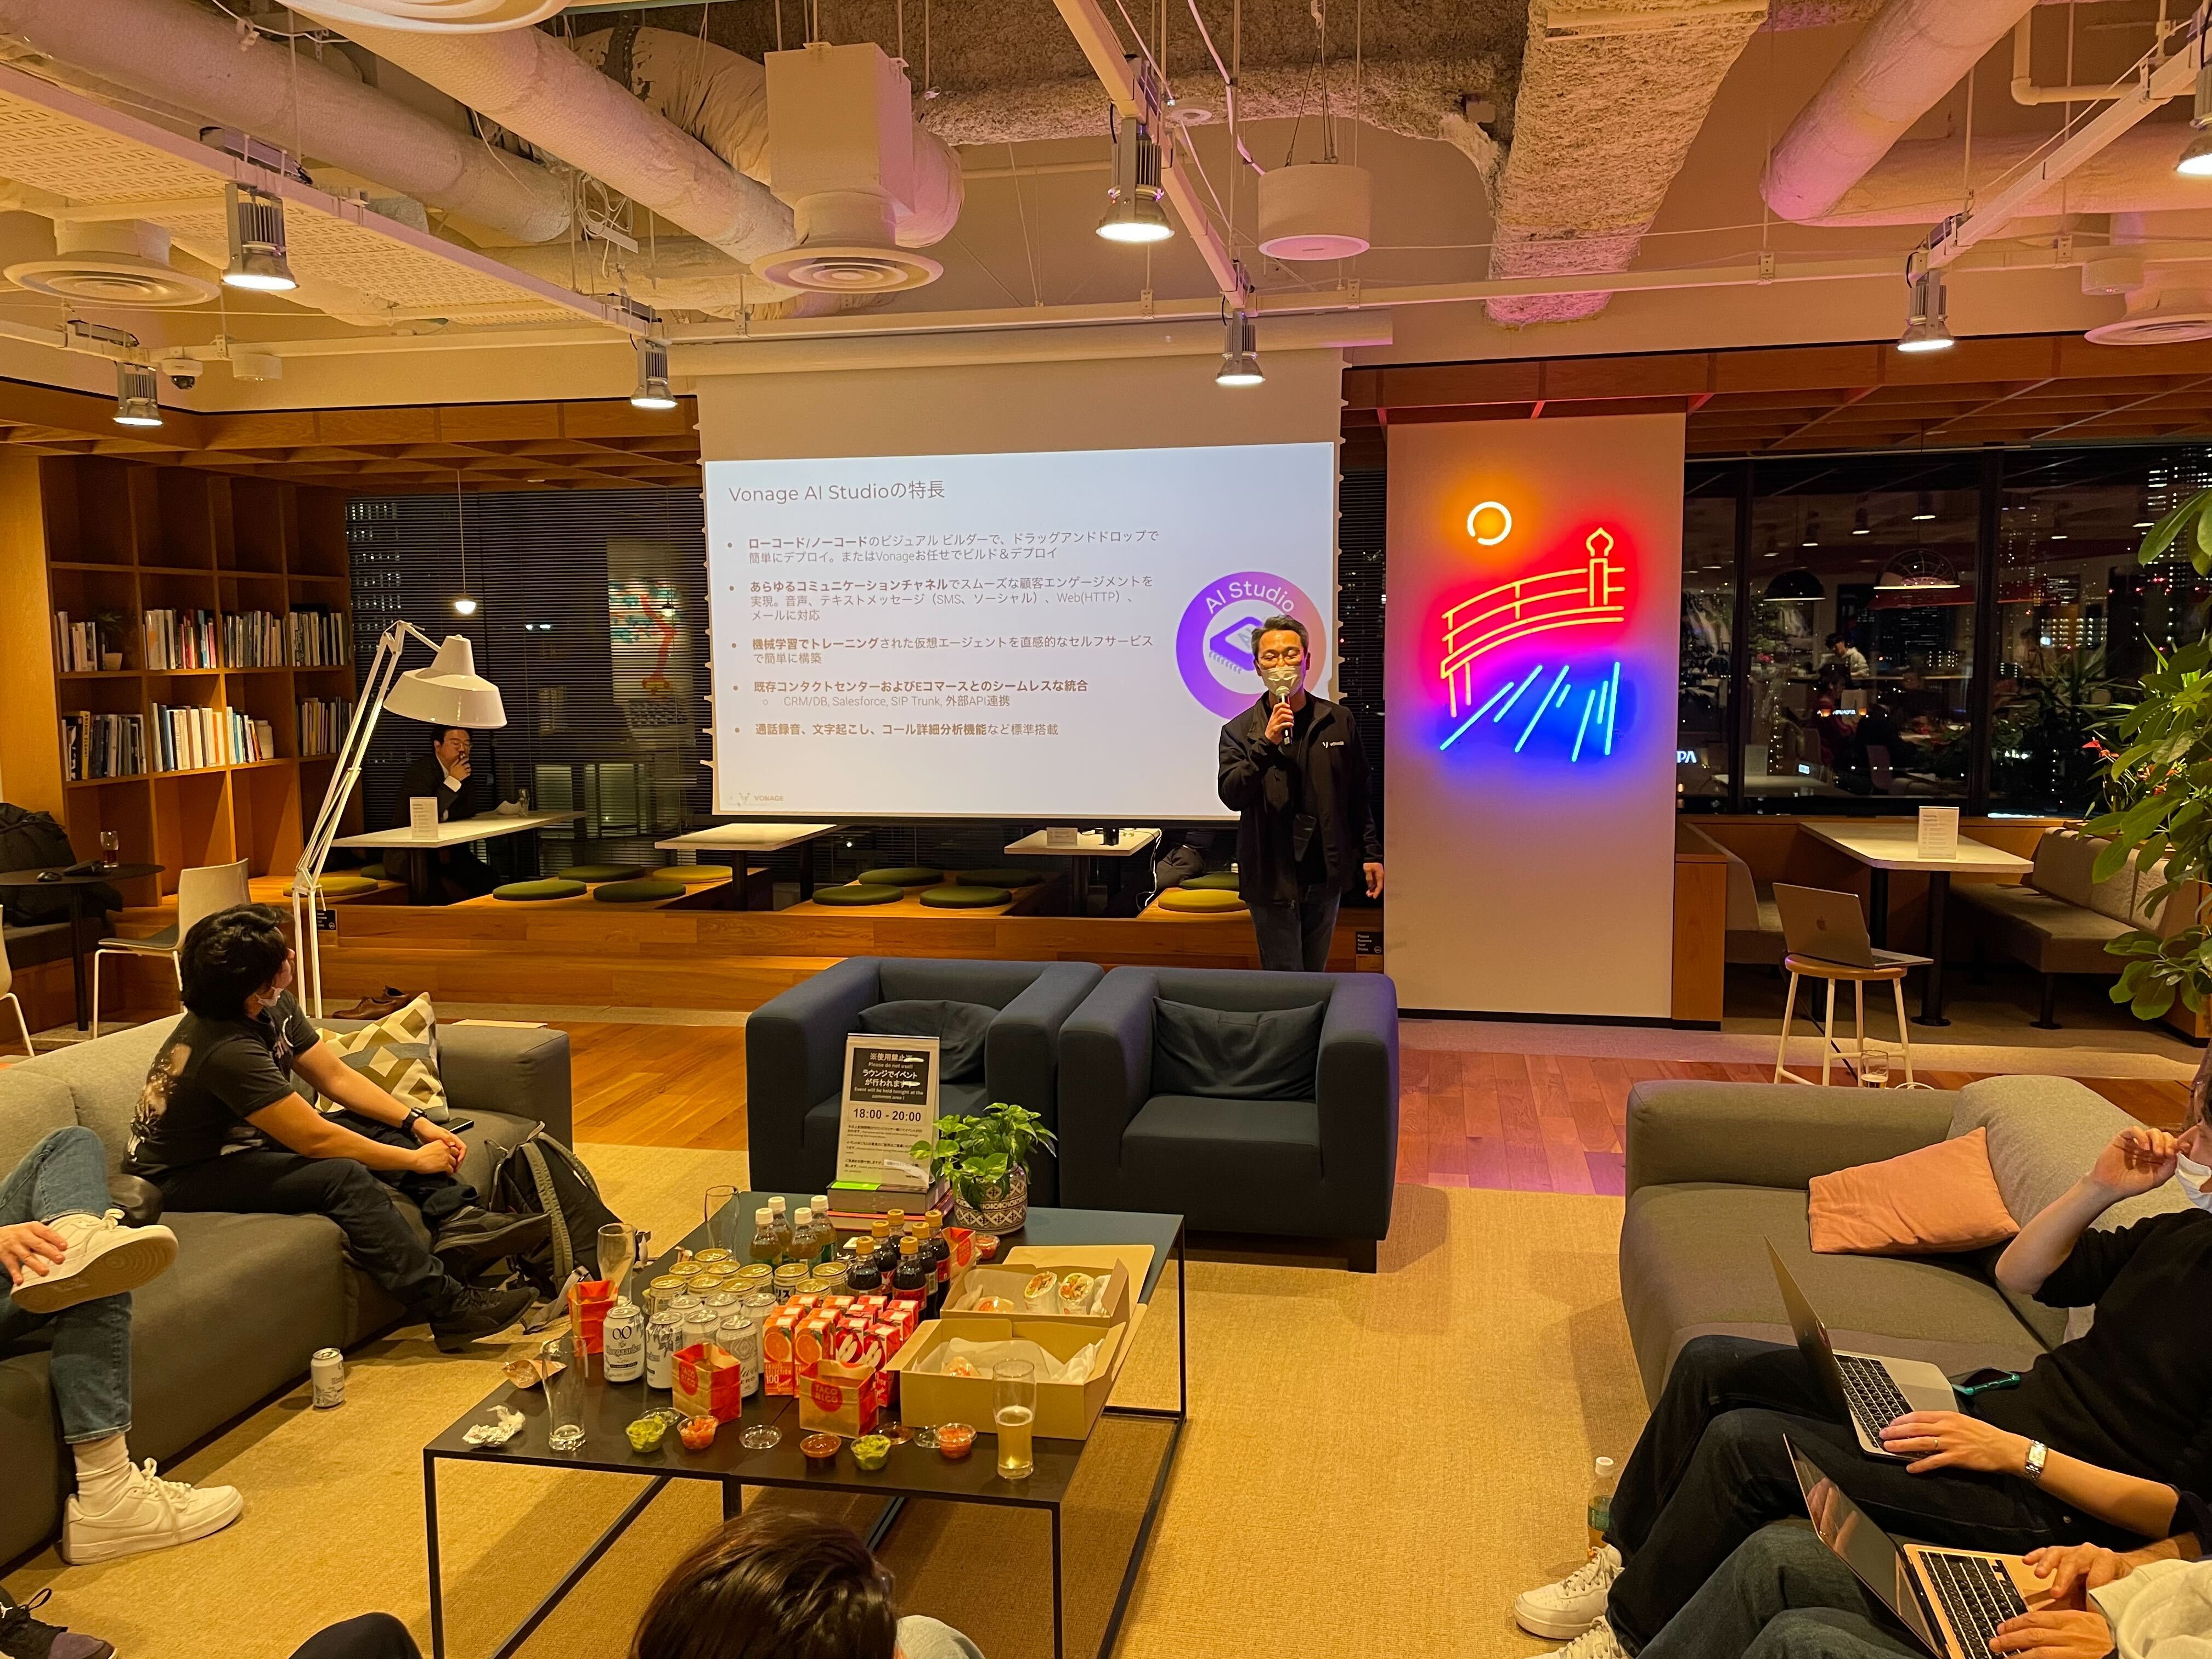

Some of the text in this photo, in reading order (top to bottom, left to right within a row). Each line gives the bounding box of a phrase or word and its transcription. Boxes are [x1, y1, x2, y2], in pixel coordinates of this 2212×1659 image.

[729, 480, 945, 504] Vonage AI Studioの特長
[1206, 581, 1294, 614] AI Studio
[752, 609, 820, 622] メールに対応
[752, 635, 1153, 650] 機械学習でトレーニングされた仮想エージェントを直感的なセルフサービス
[753, 652, 822, 665] で簡単に構築
[754, 680, 1088, 693] 既存コンタクトセンターおよびEコマースとのシームレスな統合
[783, 695, 1011, 708] CRM/DB, Salesforce, SIP Trunk, 外部API連携
[862, 1069, 918, 1080] ラウンジでイベント
[853, 1108, 882, 1119] 18:00
[892, 1110, 921, 1122] 20:00
[740, 1376, 755, 1384] ERO
[766, 1374, 780, 1384] 100
[815, 1384, 838, 1396] TACO
[815, 1392, 838, 1403] RICO
